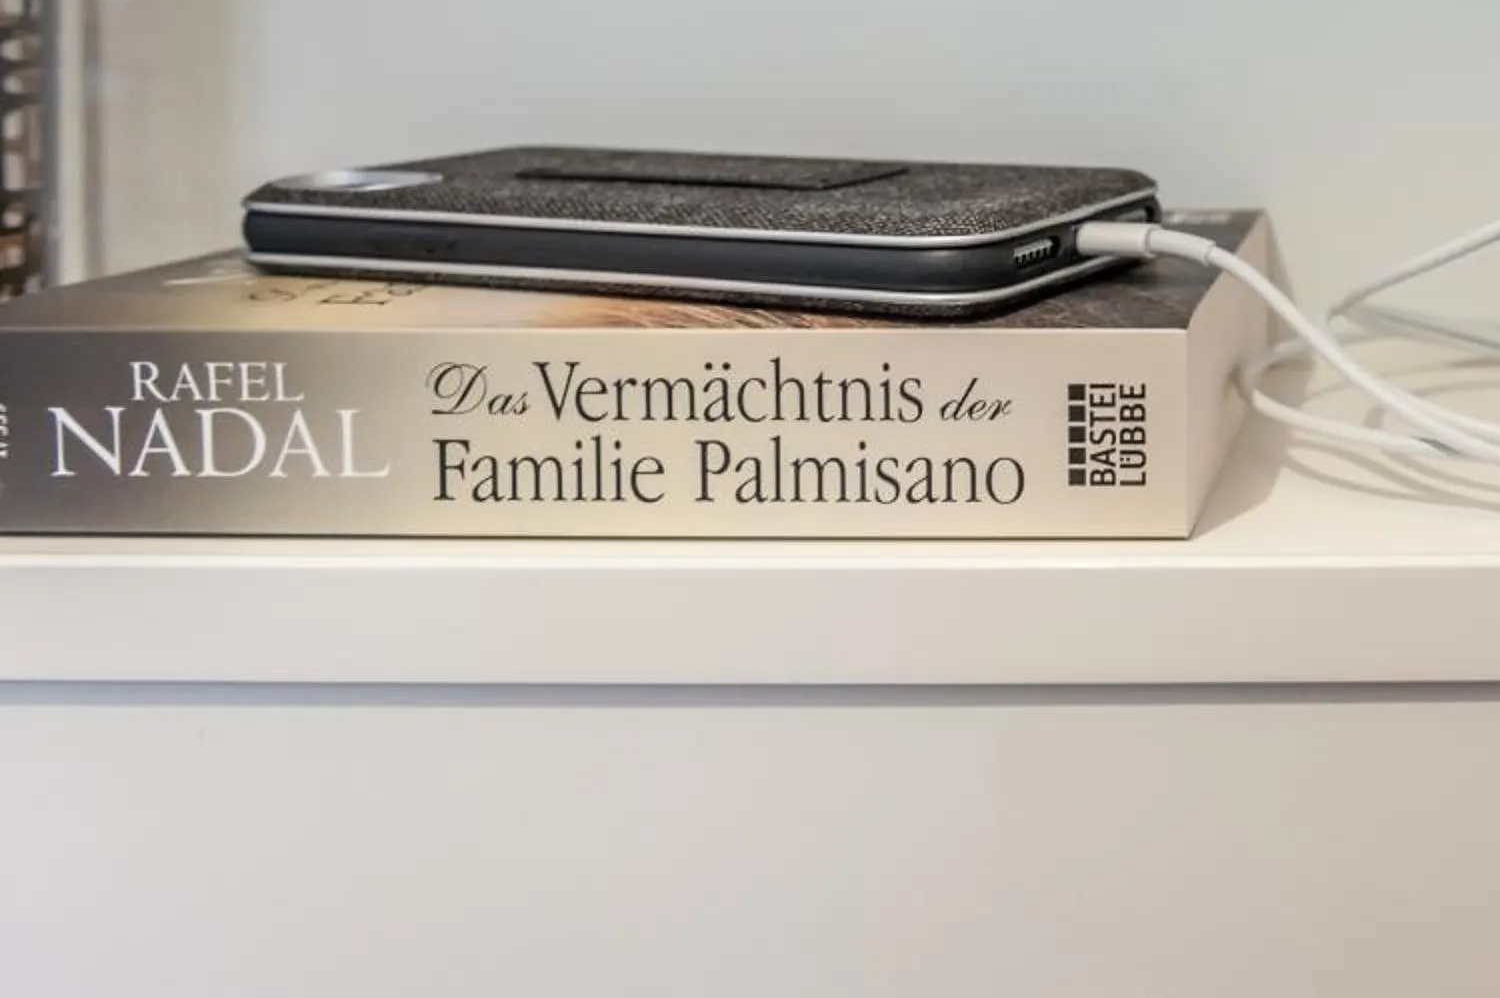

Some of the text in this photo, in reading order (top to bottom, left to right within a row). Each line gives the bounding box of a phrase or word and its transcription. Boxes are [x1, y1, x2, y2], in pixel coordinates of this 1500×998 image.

[131, 361, 304, 402] RAFEL
[425, 357, 1012, 423] Das Vermächtnis der
[49, 406, 390, 478] NADAL
[431, 433, 1025, 504] Familie Palmisano
[1089, 382, 1117, 487] BASTEI
[1119, 382, 1147, 487] LÜBBE
